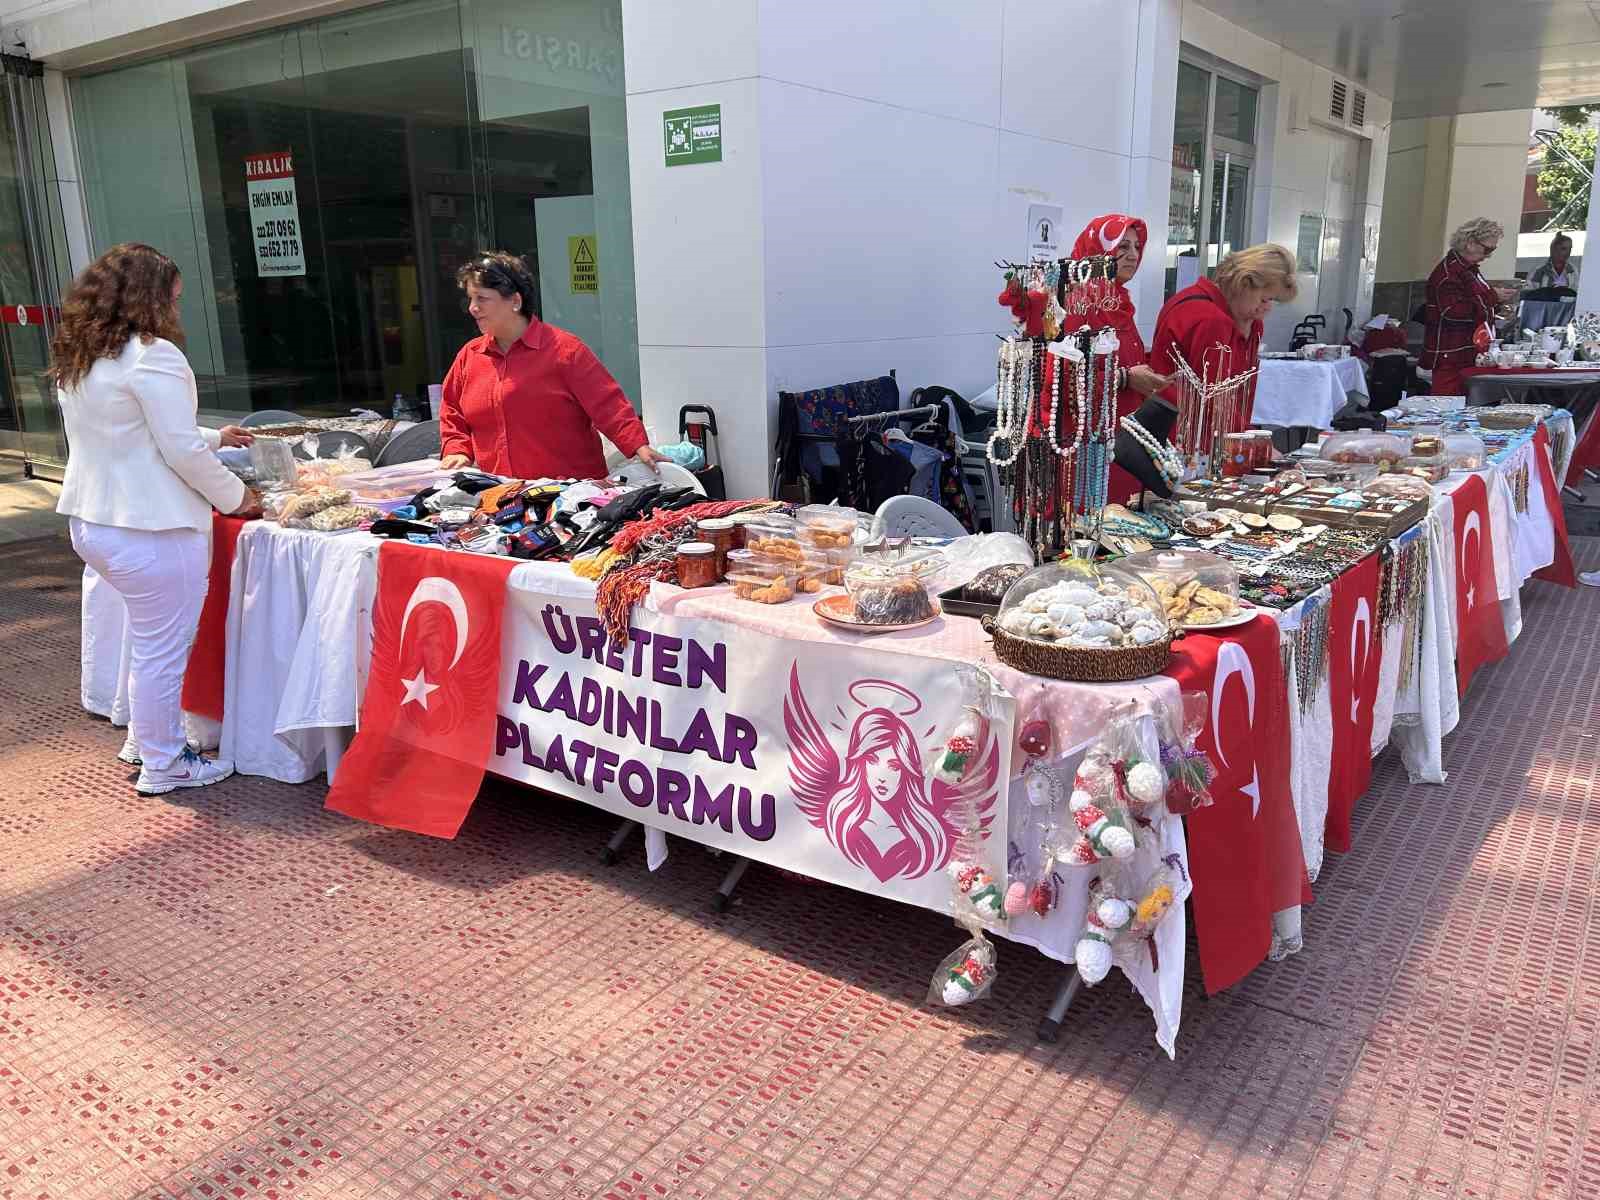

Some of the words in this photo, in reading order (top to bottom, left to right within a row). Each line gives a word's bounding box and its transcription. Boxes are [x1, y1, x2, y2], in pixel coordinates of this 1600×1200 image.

[271, 190, 294, 207] EMLAK
[512, 659, 758, 770] KADINLAR
[495, 714, 777, 842] PLATFORMU
